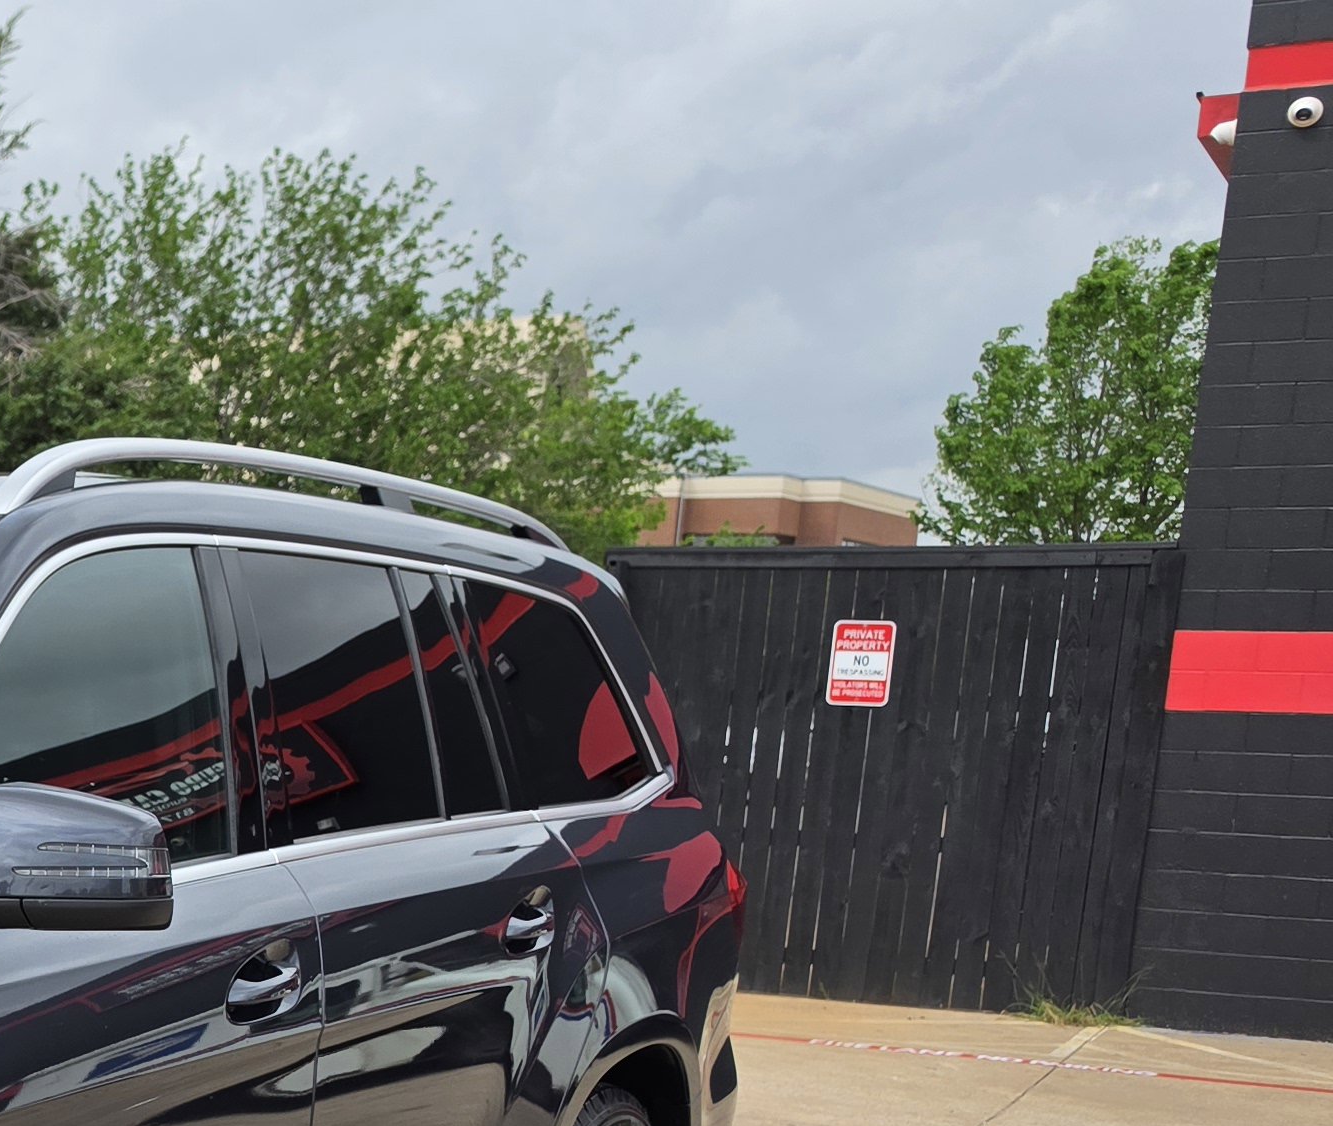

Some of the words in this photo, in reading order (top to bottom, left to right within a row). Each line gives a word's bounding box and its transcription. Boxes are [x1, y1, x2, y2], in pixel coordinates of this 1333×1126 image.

[843, 629, 886, 640] PRIVATE
[836, 640, 891, 651] PROPERTY
[853, 655, 870, 666] NO
